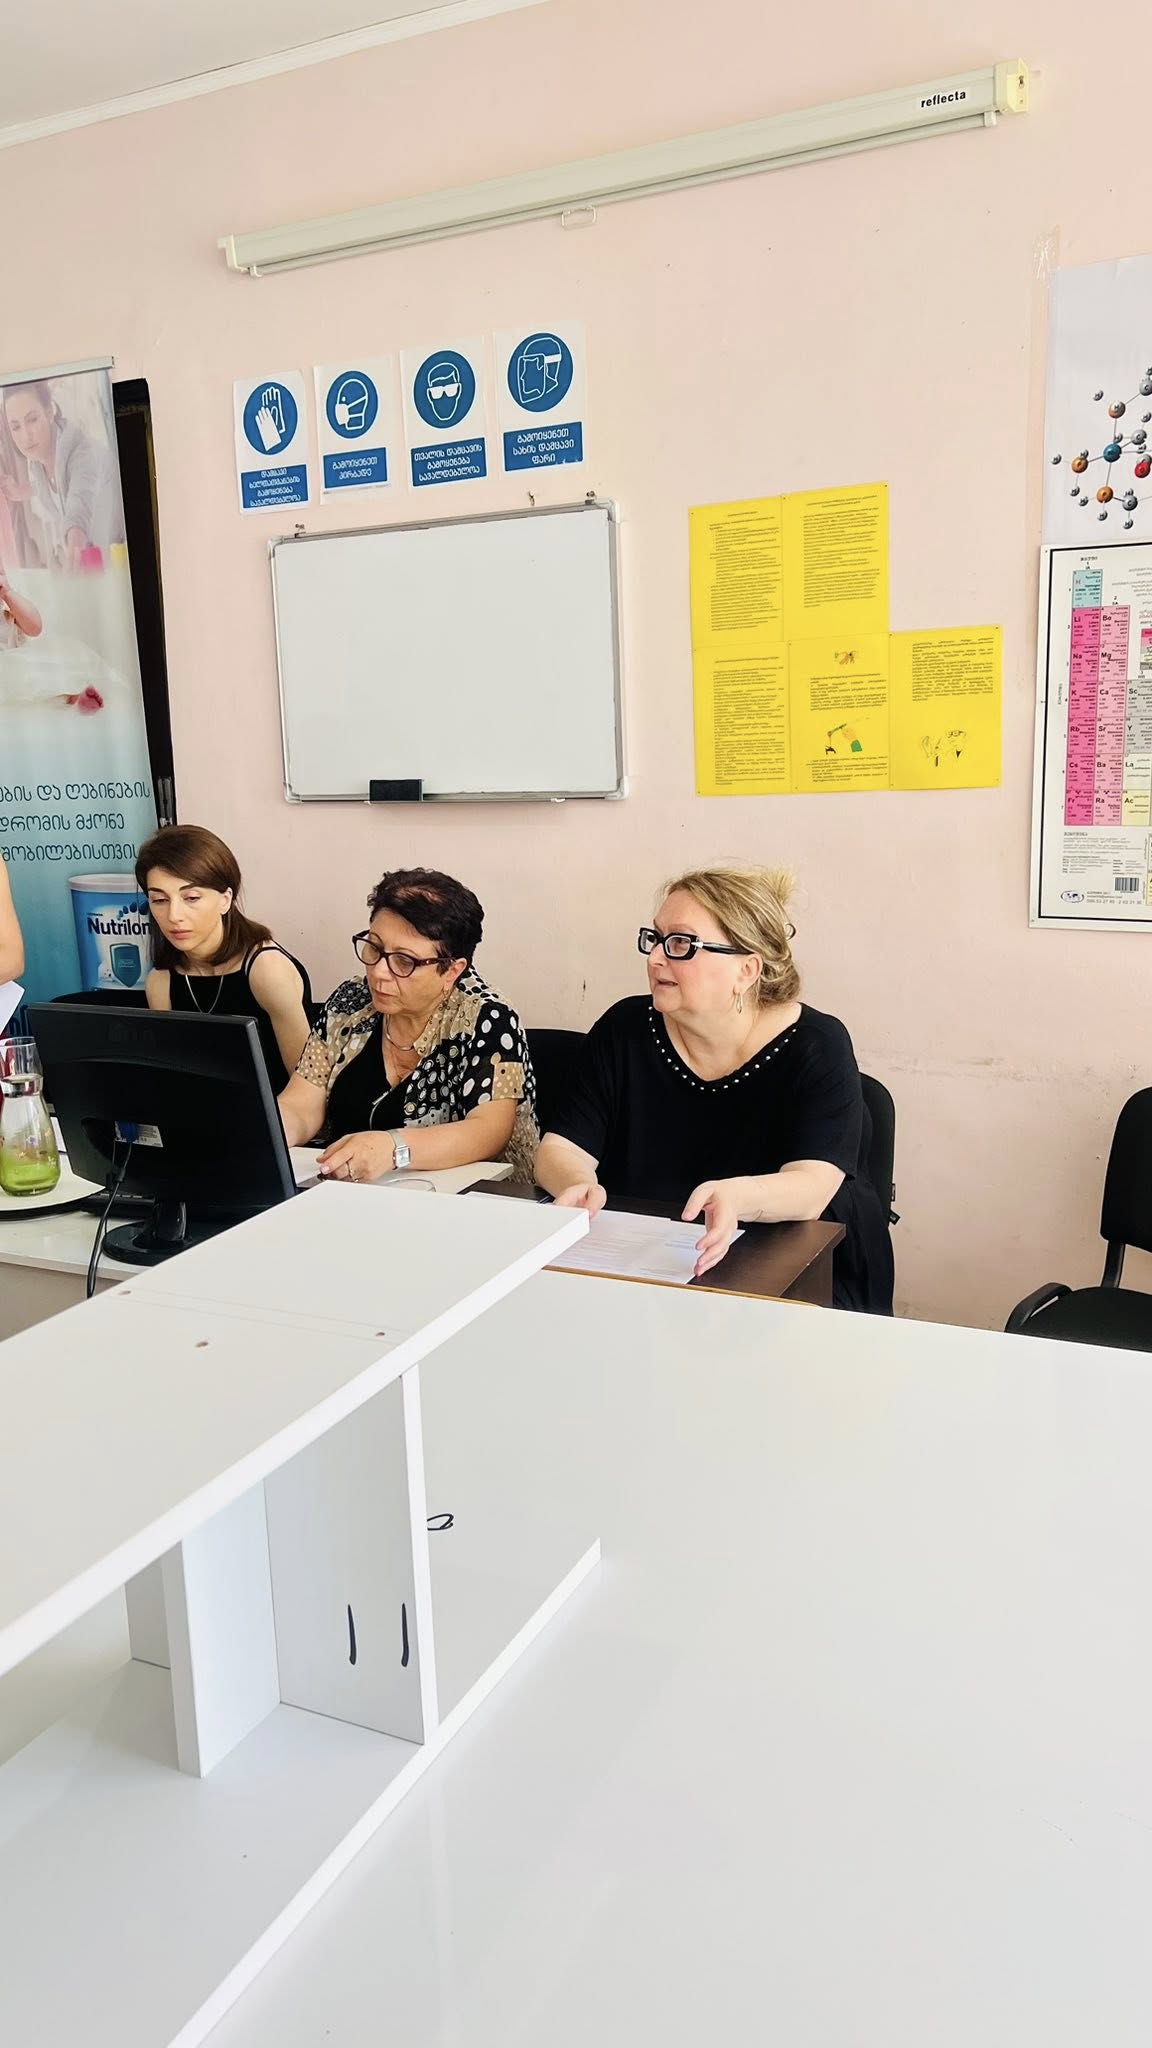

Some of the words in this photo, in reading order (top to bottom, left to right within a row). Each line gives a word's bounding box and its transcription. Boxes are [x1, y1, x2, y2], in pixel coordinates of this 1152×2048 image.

[921, 91, 966, 108] reflecta
[517, 428, 569, 443] გამოიყენეთ
[538, 438, 574, 452] დამცავი
[531, 453, 556, 465] ფარი
[1101, 652, 1112, 660] Mg
[37, 784, 61, 801] და
[66, 782, 150, 800] ღებინების
[76, 813, 124, 830] მქონე
